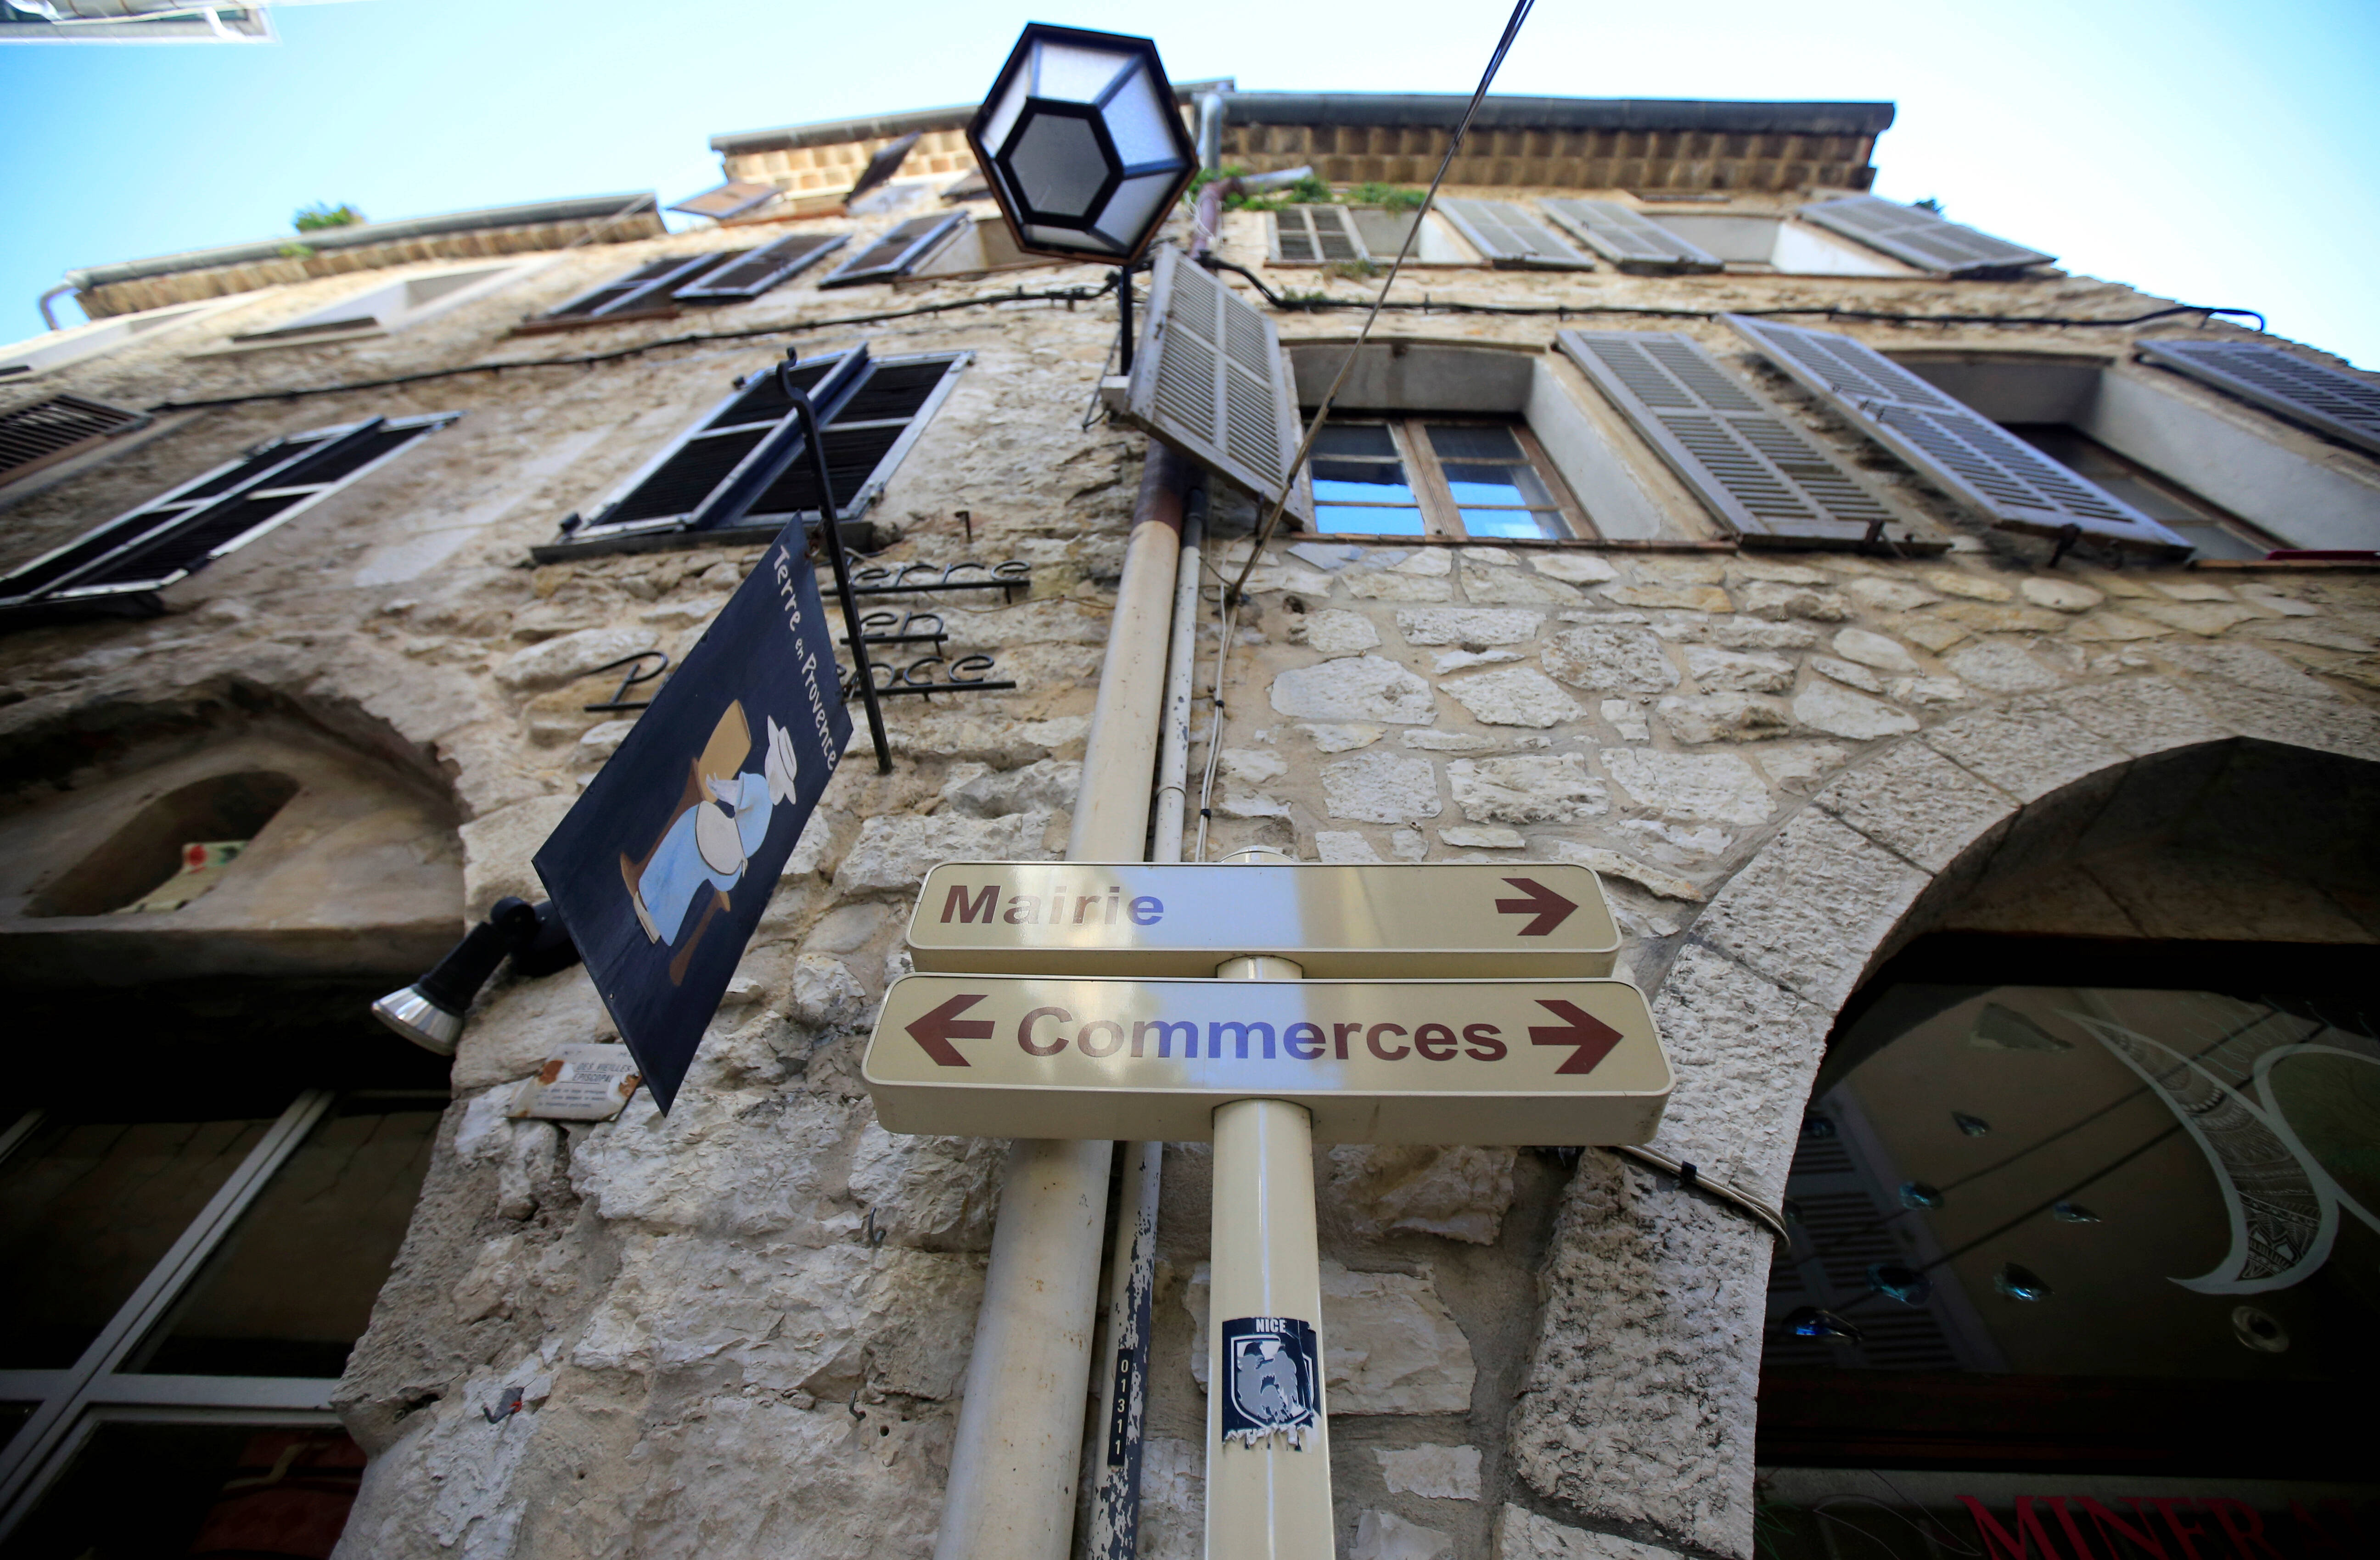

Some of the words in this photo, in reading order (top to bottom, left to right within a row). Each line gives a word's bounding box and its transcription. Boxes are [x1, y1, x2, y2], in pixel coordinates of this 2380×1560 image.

[774, 544, 801, 632] Terre
[795, 637, 805, 661] en
[801, 651, 836, 771] Provence
[940, 885, 1165, 926] Mairie
[1016, 1006, 1509, 1062] Commerces
[1256, 1318, 1287, 1333] NICE
[1115, 1359, 1129, 1455] 01311
